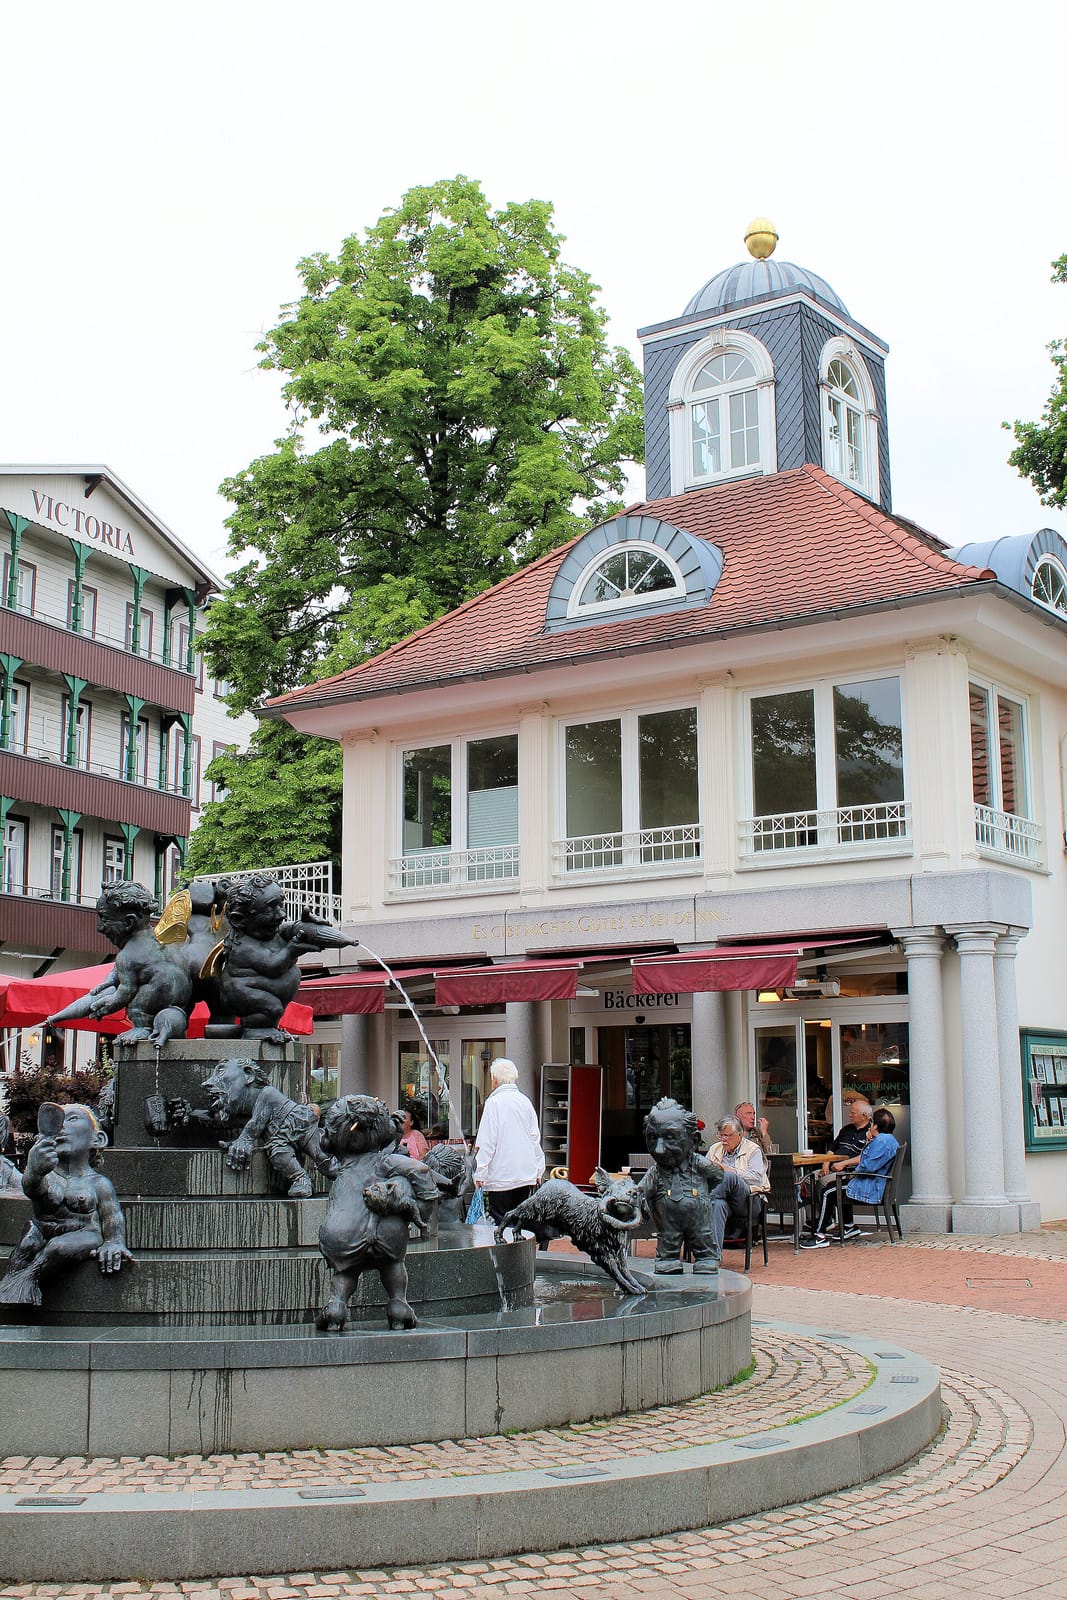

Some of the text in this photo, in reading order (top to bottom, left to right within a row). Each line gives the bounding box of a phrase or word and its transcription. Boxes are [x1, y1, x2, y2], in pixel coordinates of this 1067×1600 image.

[31, 489, 135, 556] VICTORIA
[577, 915, 624, 933] GUTES
[630, 914, 646, 928] ES
[649, 911, 669, 928] SEI
[604, 990, 679, 1009] Bäckerei
